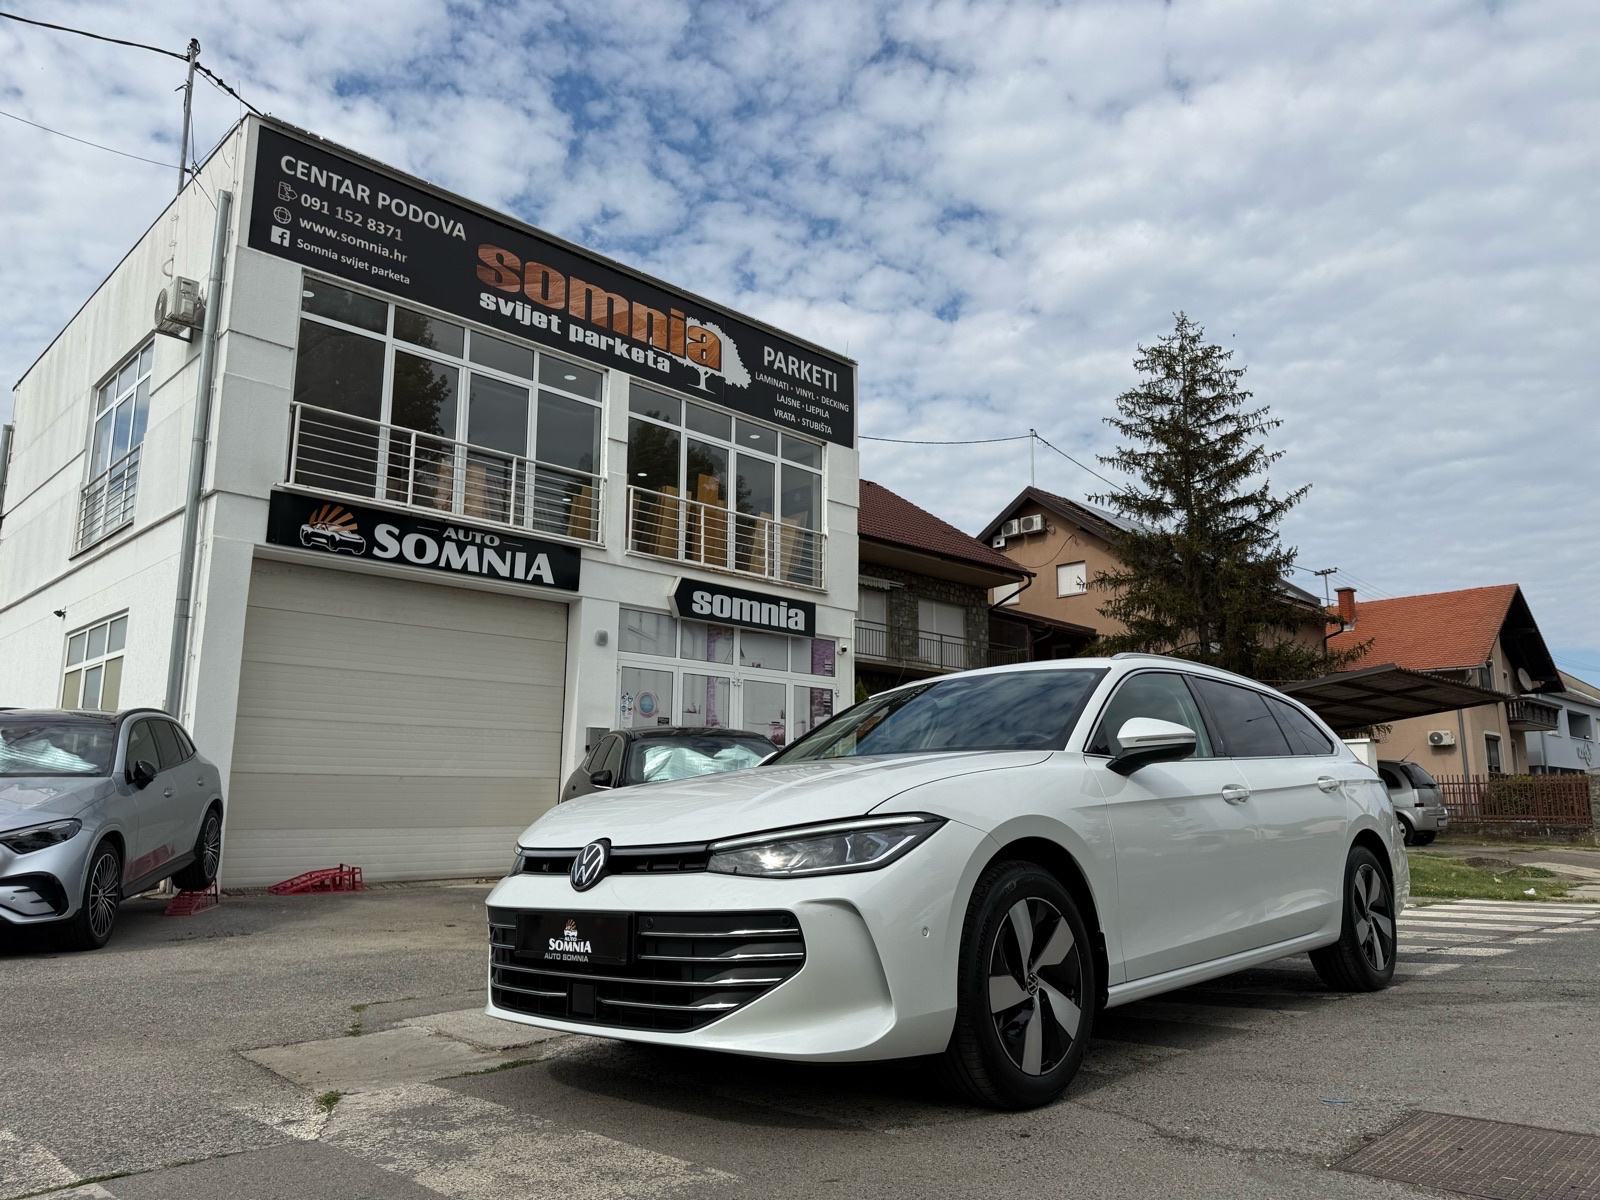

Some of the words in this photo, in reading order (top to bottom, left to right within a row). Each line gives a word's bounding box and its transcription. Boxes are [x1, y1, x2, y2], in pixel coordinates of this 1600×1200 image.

[281, 155, 370, 204] CENTAR
[377, 192, 466, 240] PODOVA
[301, 194, 330, 215] 091
[335, 206, 362, 227] 152
[367, 218, 402, 241] 8371
[297, 238, 338, 260] Somnia
[341, 254, 369, 271] svijet
[371, 264, 410, 284] parketa
[299, 218, 408, 263] www.somnia.hr
[476, 244, 721, 371] somnia
[479, 292, 562, 335] svijet
[569, 324, 670, 373] parketa
[764, 346, 837, 392] PARKETI
[755, 372, 789, 391] LAMINATI
[795, 386, 815, 400] VINYL
[821, 396, 849, 412] DECKING
[777, 394, 801, 408] LAJSNE
[805, 404, 830, 418] LJEPILA
[773, 408, 796, 422] VRATA
[801, 418, 832, 434] STUBIŠTA
[372, 523, 556, 585] SOMNIA
[442, 527, 501, 547] AUTO
[691, 590, 806, 632] somnia
[544, 952, 561, 960] AUTO
[562, 954, 589, 962] SOMNIA
[548, 938, 592, 953] SOMNIA
